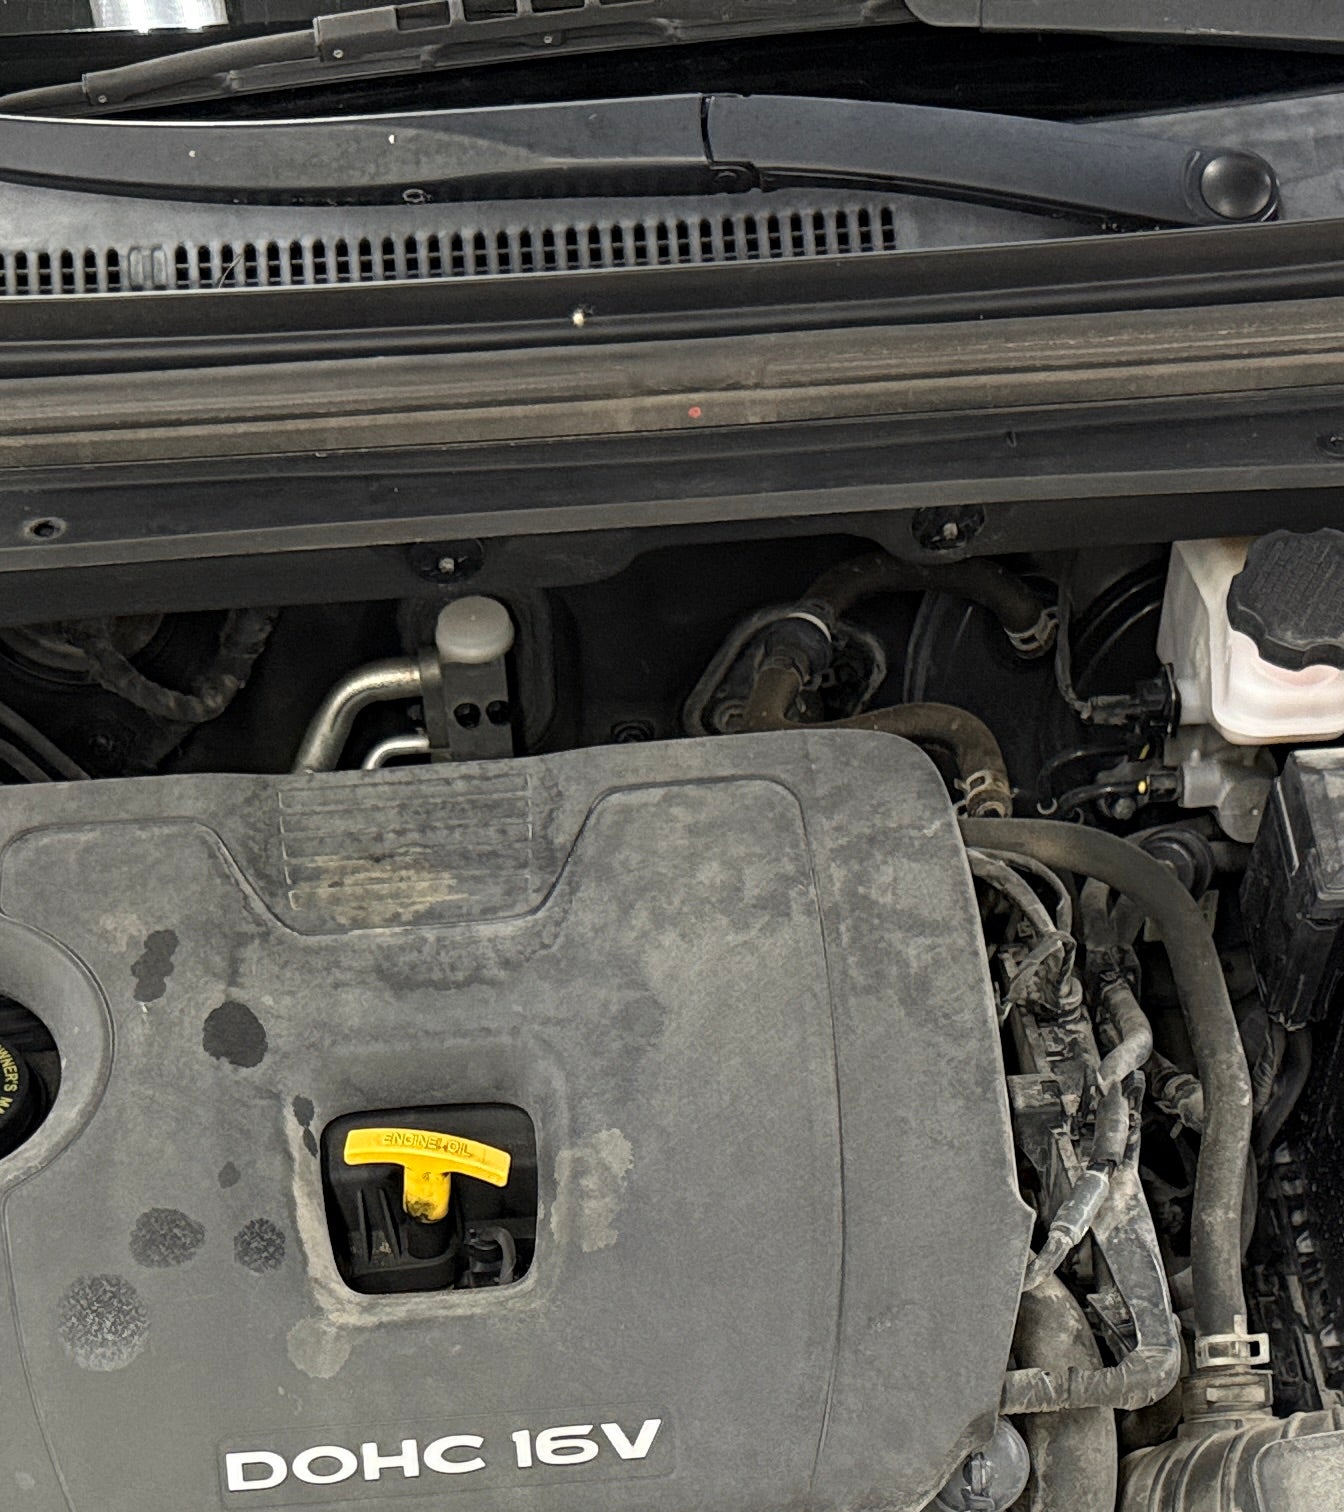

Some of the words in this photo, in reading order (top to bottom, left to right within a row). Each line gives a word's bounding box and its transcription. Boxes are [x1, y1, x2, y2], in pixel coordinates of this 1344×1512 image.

[382, 1131, 440, 1151] ENGINE
[446, 1140, 474, 1159] OIL
[223, 1433, 486, 1493] DOHC
[511, 1417, 663, 1469] 16V
